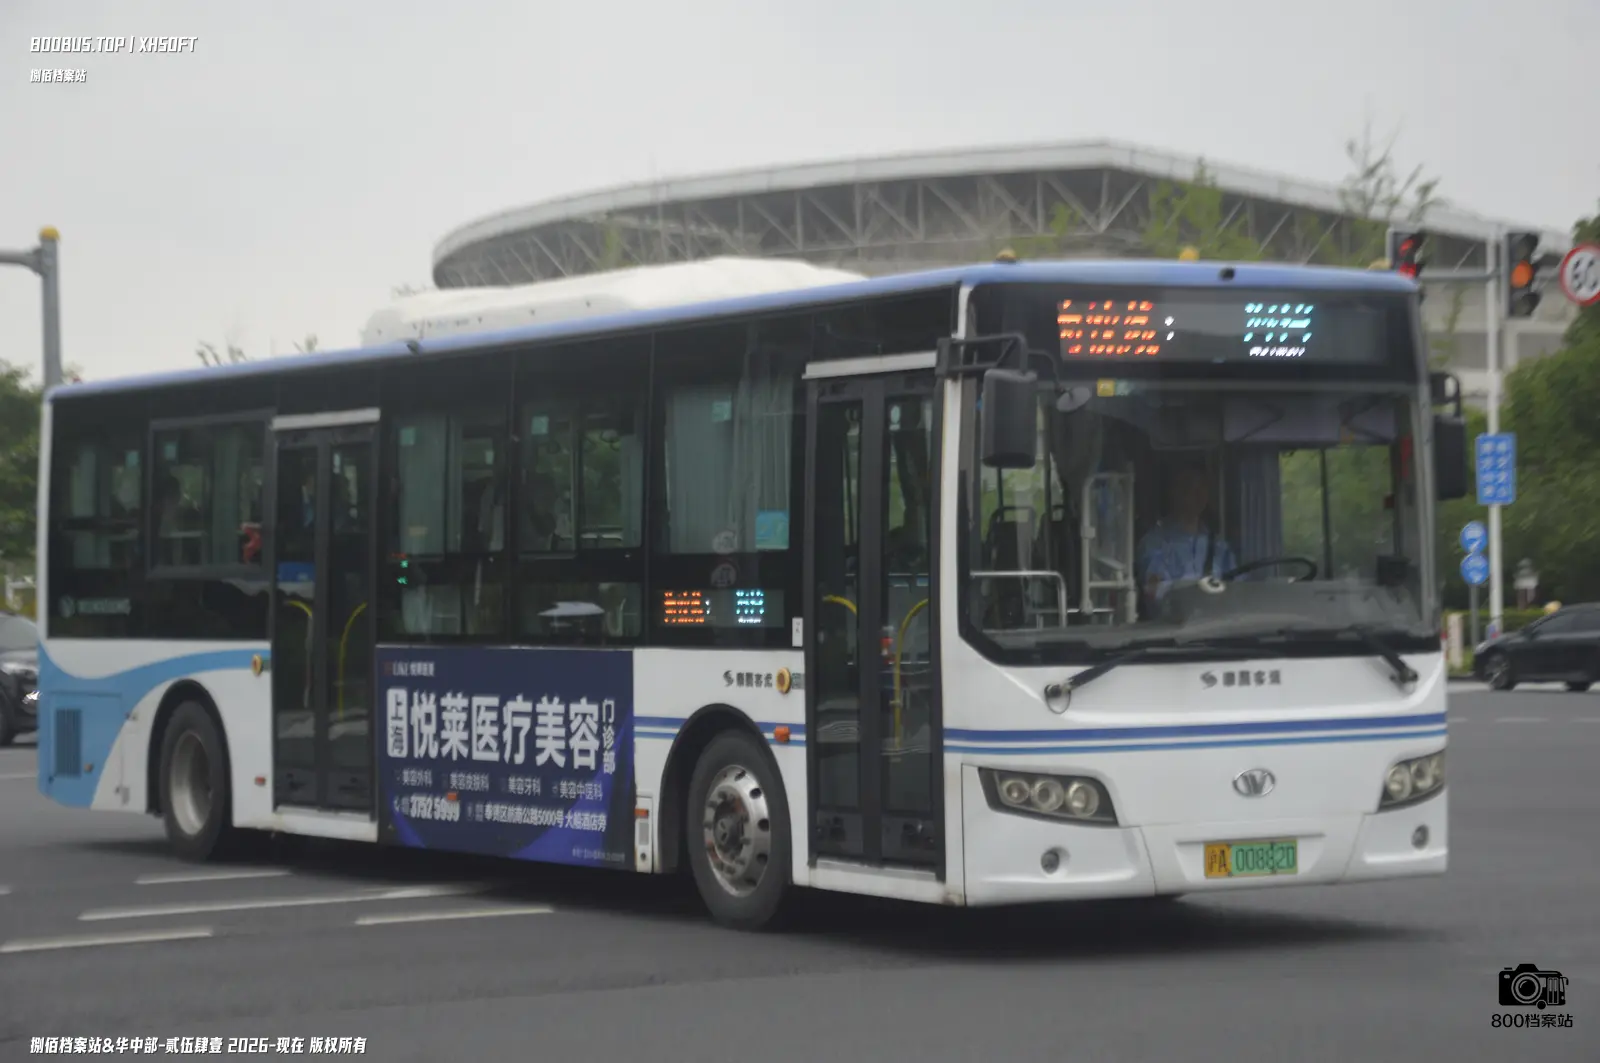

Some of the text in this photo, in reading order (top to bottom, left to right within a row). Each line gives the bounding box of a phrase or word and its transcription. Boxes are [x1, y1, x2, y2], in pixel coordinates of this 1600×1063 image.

[410, 690, 601, 771] 悦莱医疗美容
[602, 699, 616, 775] 门诊部
[508, 776, 541, 797] 美容牙科
[560, 781, 603, 801] 美容中医科
